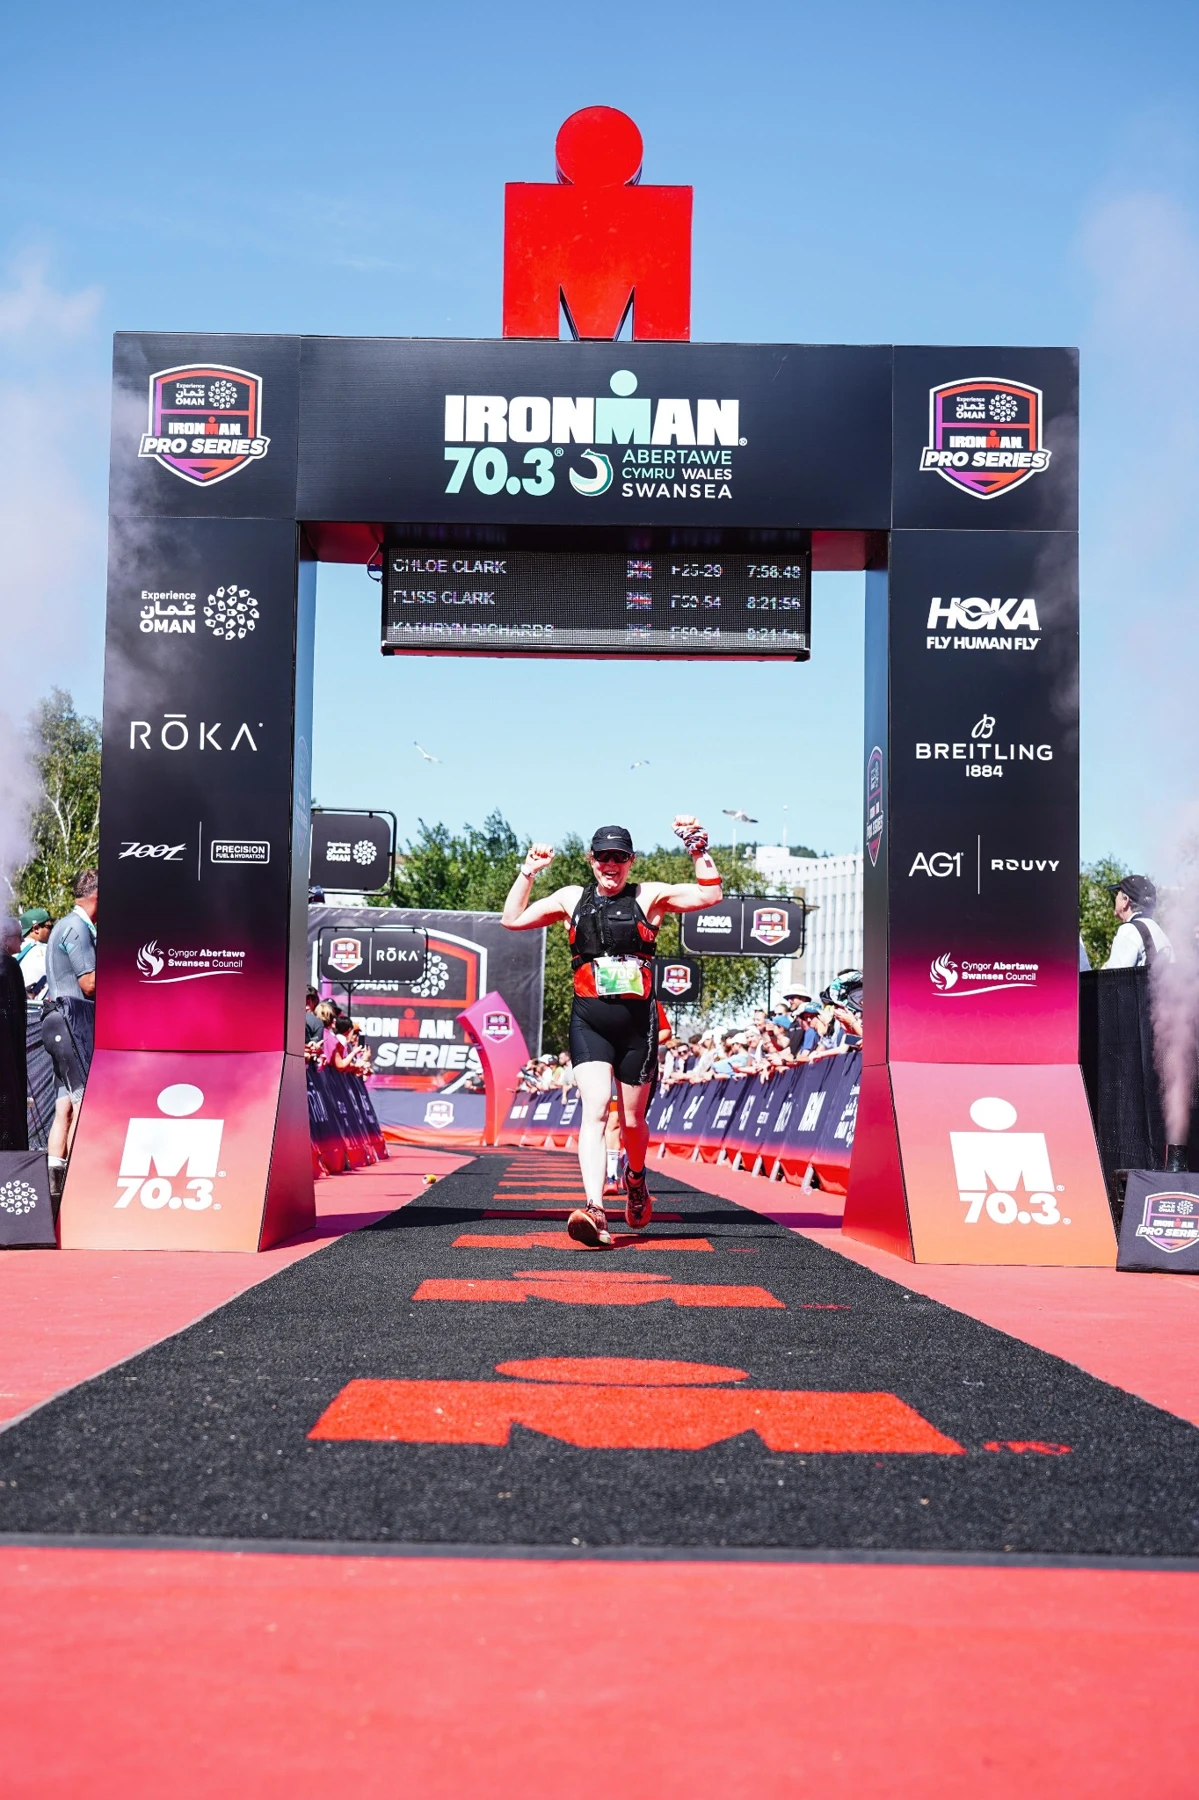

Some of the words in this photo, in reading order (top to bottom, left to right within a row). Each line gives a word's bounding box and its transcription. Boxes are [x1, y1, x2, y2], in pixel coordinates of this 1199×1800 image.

[956, 411, 985, 419] OMAN
[168, 422, 242, 435] IRONMAN
[143, 438, 188, 453] PRO
[189, 439, 265, 455] SERIES
[949, 435, 1023, 448] IRONMAN
[622, 450, 732, 465] ABERTAWE
[924, 451, 969, 467] PRO
[971, 452, 1046, 468] SERIES
[622, 467, 675, 480] CYMRU
[682, 468, 732, 480] WALES
[621, 482, 733, 499] SWANSEA
[392, 559, 448, 572] CHLOE
[452, 560, 507, 574] CLARK
[141, 591, 196, 601] Experience
[441, 591, 495, 604] CLARK
[927, 597, 1041, 630] HOKA
[139, 619, 196, 634] OMAN
[927, 636, 952, 650] FLY
[954, 637, 1012, 650] HUMAN
[1014, 637, 1040, 650] FLY
[915, 743, 1053, 761] BREITLING
[965, 765, 1004, 778] 1884
[215, 845, 266, 854] PRECISION
[908, 852, 962, 877] AG1
[991, 859, 1060, 872] ROUVY
[697, 915, 733, 928] HOKA
[167, 948, 198, 958] Cyngor
[199, 949, 246, 958] Abertawe
[167, 958, 210, 968] Swansea
[212, 959, 243, 968] Council
[961, 961, 992, 972] Cyngor
[992, 962, 1039, 971] Abertawe
[609, 969, 635, 981] 706
[961, 972, 1004, 981] Swansea
[1005, 972, 1037, 981] Council
[113, 1178, 215, 1211] 70.3
[959, 1192, 1061, 1225] 70.3
[1139, 1227, 1164, 1236] PRO
[1164, 1228, 1199, 1238] SERIE
